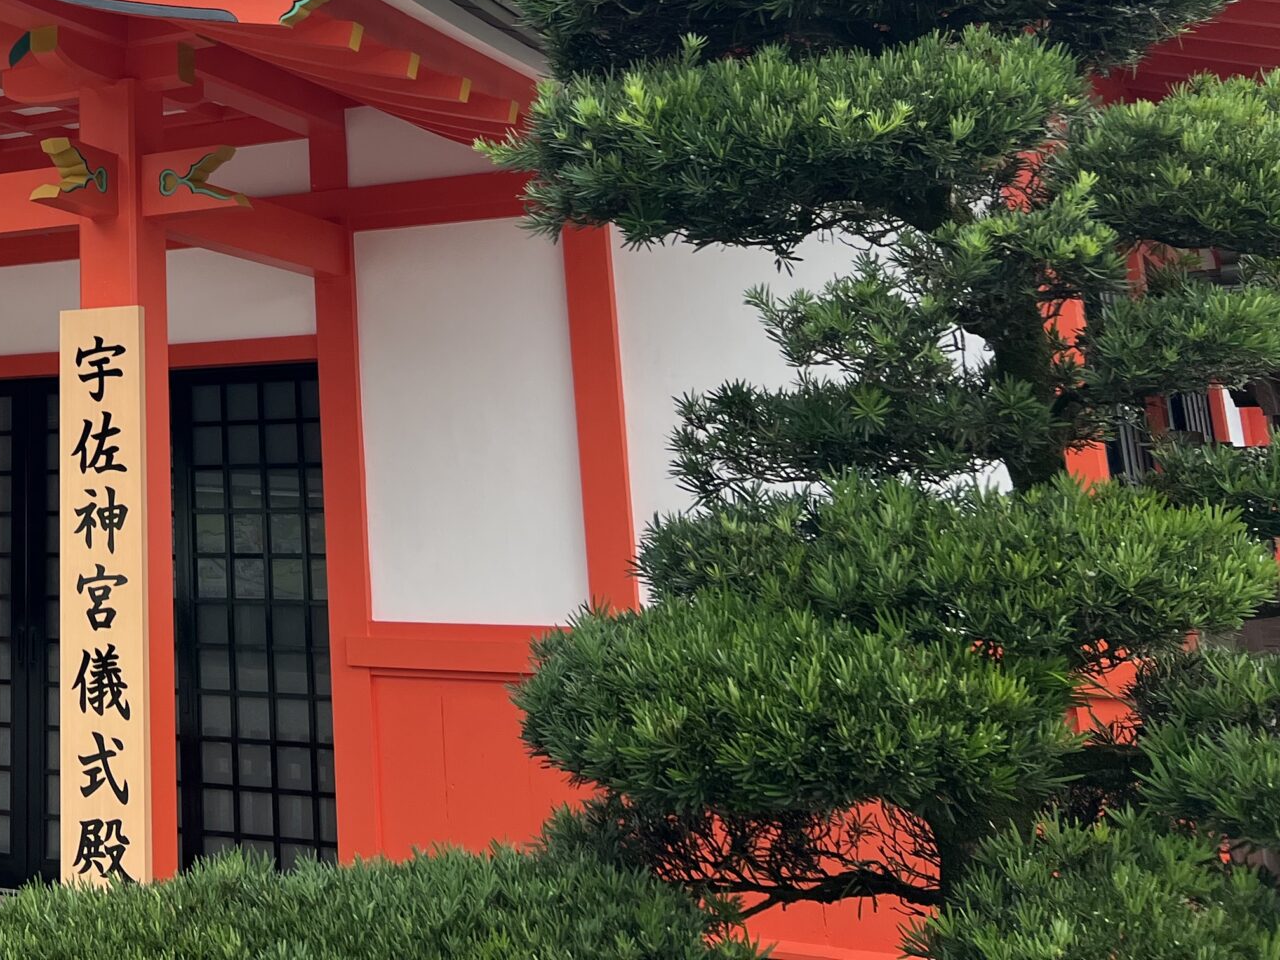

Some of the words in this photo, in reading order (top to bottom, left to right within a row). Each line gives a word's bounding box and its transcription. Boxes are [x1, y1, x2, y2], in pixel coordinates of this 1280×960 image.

[71, 335, 135, 885] 宇佐神宮儀式殿
